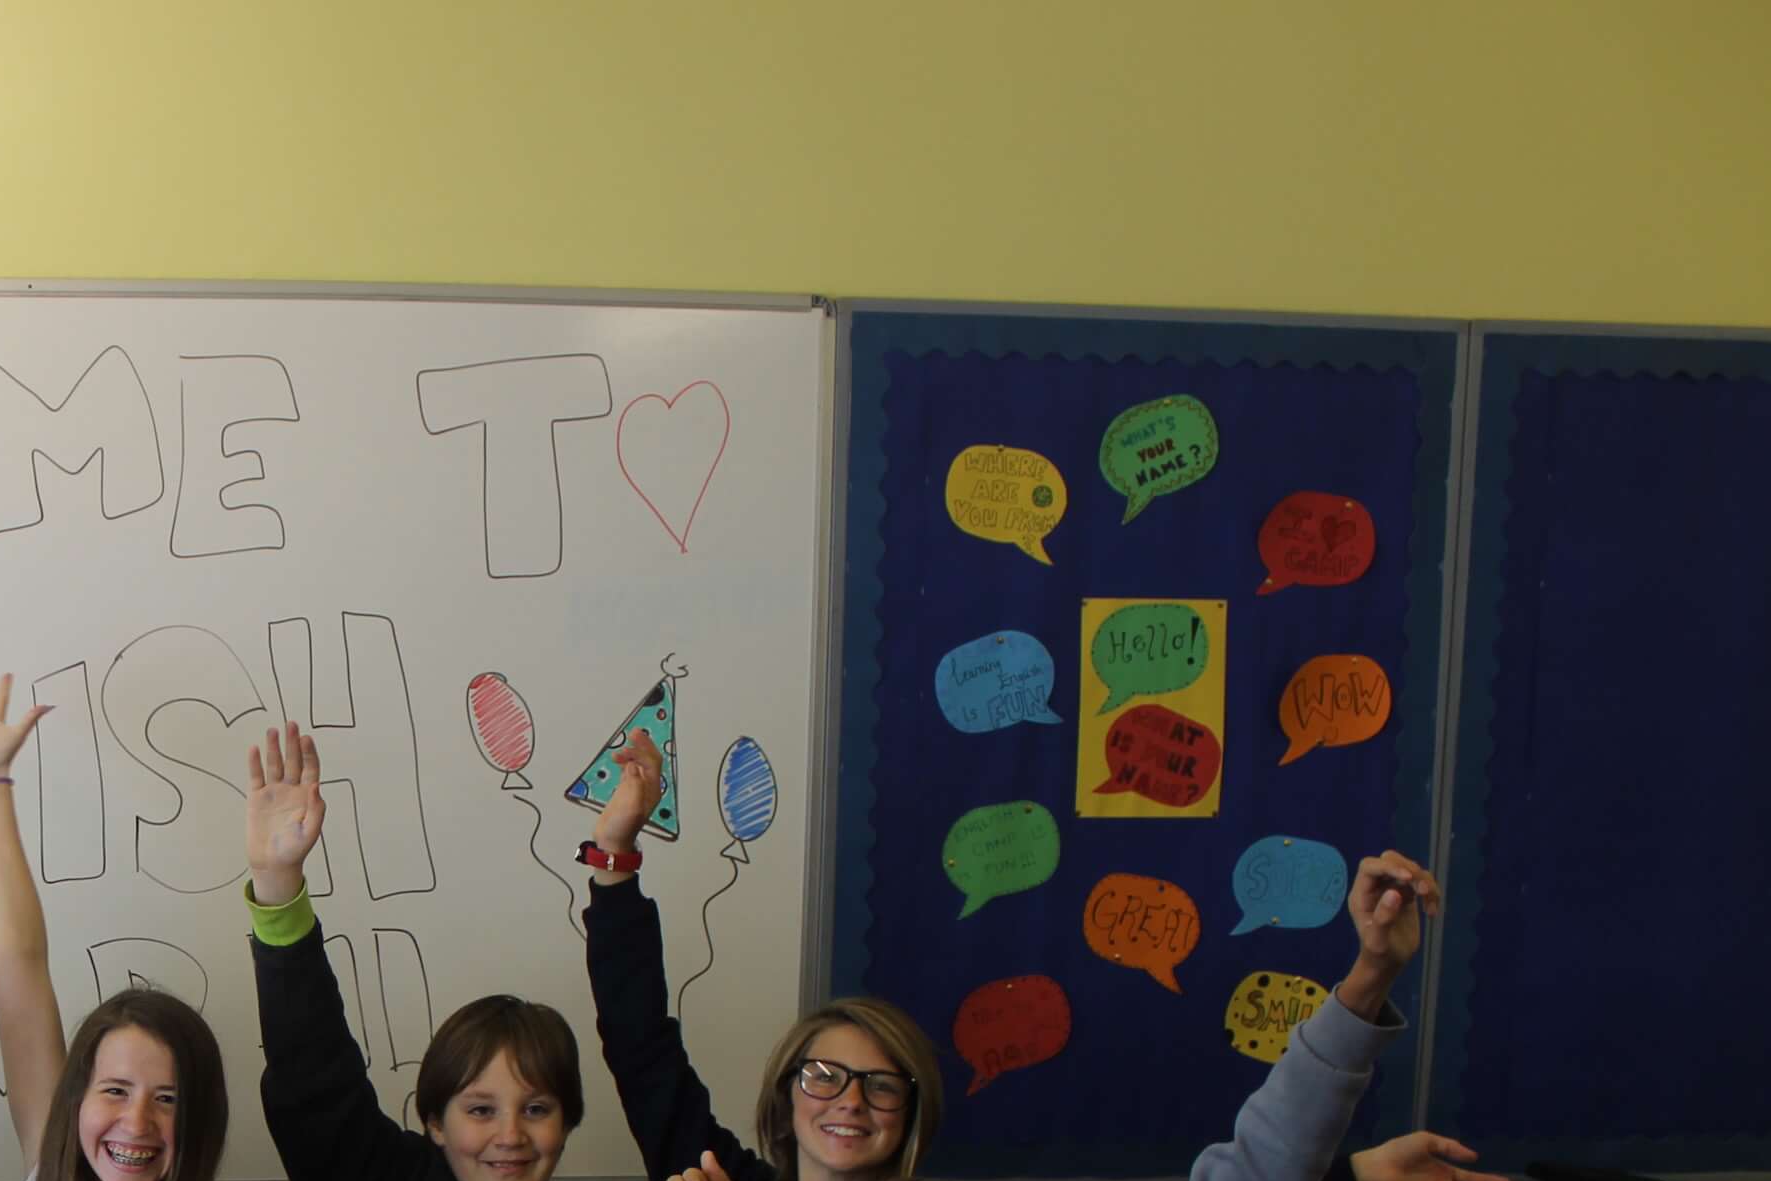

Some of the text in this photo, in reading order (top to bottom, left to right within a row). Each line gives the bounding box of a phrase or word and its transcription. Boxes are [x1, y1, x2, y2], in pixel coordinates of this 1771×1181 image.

[1137, 438, 1174, 463] YOUR
[965, 453, 1045, 481] WHERE
[971, 479, 1020, 502] ARE
[954, 499, 998, 528] YOU
[1107, 616, 1200, 665] Hello!
[987, 685, 1047, 729] FUN
[1110, 730, 1134, 753] IS
[1091, 890, 1194, 953] GREAT
